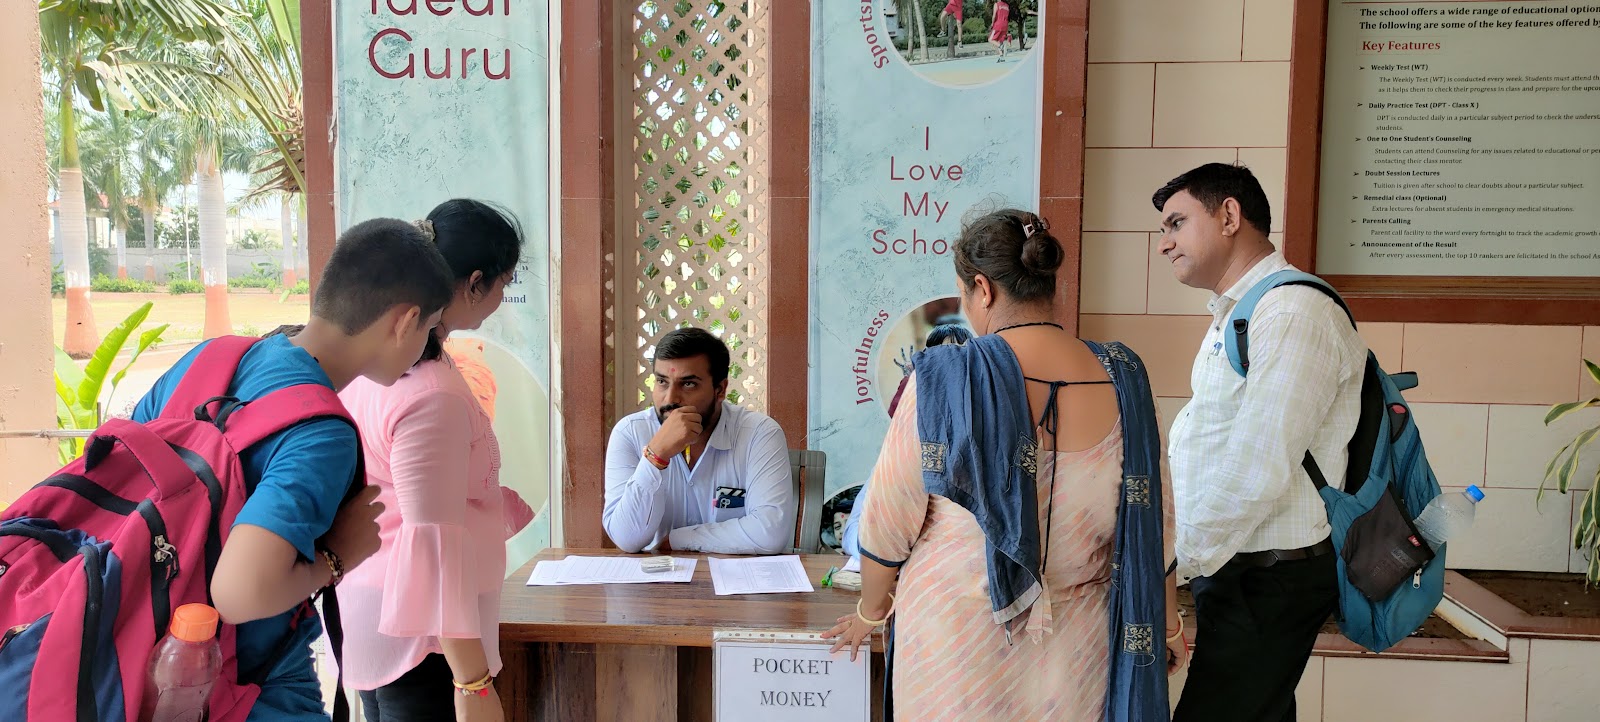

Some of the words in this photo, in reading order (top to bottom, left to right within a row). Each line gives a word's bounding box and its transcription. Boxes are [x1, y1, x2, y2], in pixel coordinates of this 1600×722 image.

[1360, 8, 1377, 16] The
[1380, 7, 1409, 16] school
[1411, 7, 1438, 15] offers
[1448, 7, 1470, 15] wide
[1472, 8, 1499, 17] range
[1501, 6, 1511, 14] of
[1512, 6, 1568, 14] educational
[859, 0, 890, 69] Sports
[1359, 21, 1376, 29] The
[1379, 20, 1422, 31] following
[1467, 20, 1478, 28] of
[1479, 19, 1494, 28] the
[1496, 19, 1512, 30] key
[1514, 18, 1554, 27] features
[1556, 18, 1590, 26] offered
[368, 27, 511, 80] Guru
[1362, 40, 1385, 53] Key
[1388, 40, 1441, 50] Features
[924, 126, 930, 151] I
[890, 156, 963, 181] Love
[903, 192, 949, 223] My
[871, 229, 949, 255] Scho
[501, 294, 527, 304] nand
[852, 309, 890, 406] Joyfulness
[753, 657, 833, 676] POCKET
[760, 689, 833, 708] MONEY
